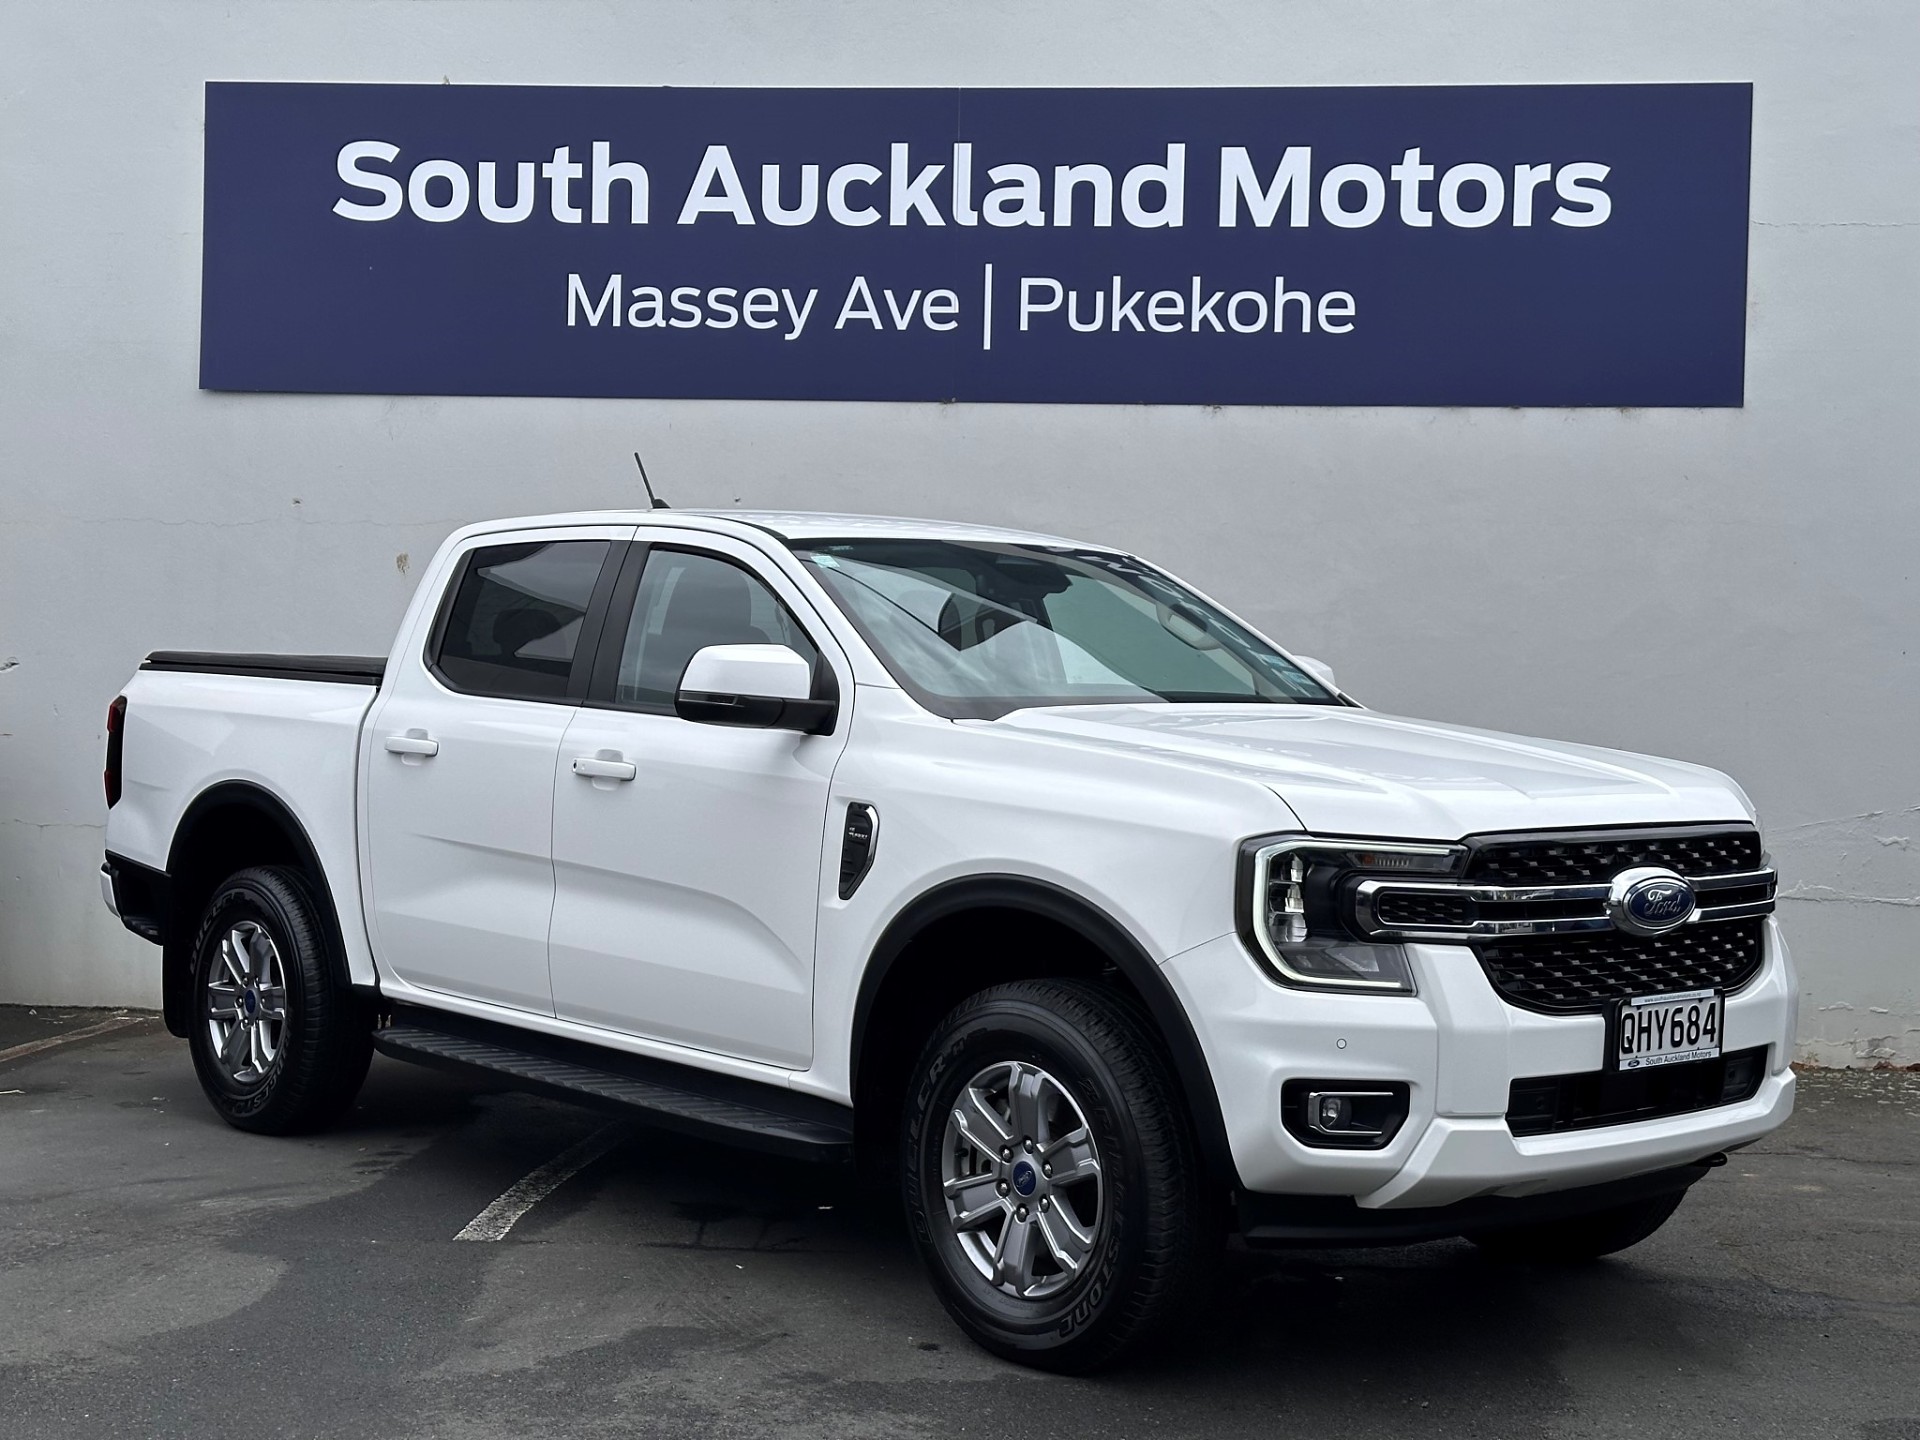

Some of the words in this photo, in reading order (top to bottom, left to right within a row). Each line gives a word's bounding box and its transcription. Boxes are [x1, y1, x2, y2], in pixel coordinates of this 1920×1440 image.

[333, 140, 649, 225] South
[677, 142, 1186, 229] Auckland
[1218, 146, 1612, 229] Motors
[567, 273, 819, 341] Massey
[835, 276, 960, 331] Ave
[1019, 275, 1356, 334] Pukekohe
[1644, 888, 1684, 916] Ford
[1621, 1002, 1717, 1054] QHY684
[1645, 1056, 1663, 1066] South
[1663, 1052, 1691, 1063] Auckland
[1691, 1050, 1712, 1060] Motors
